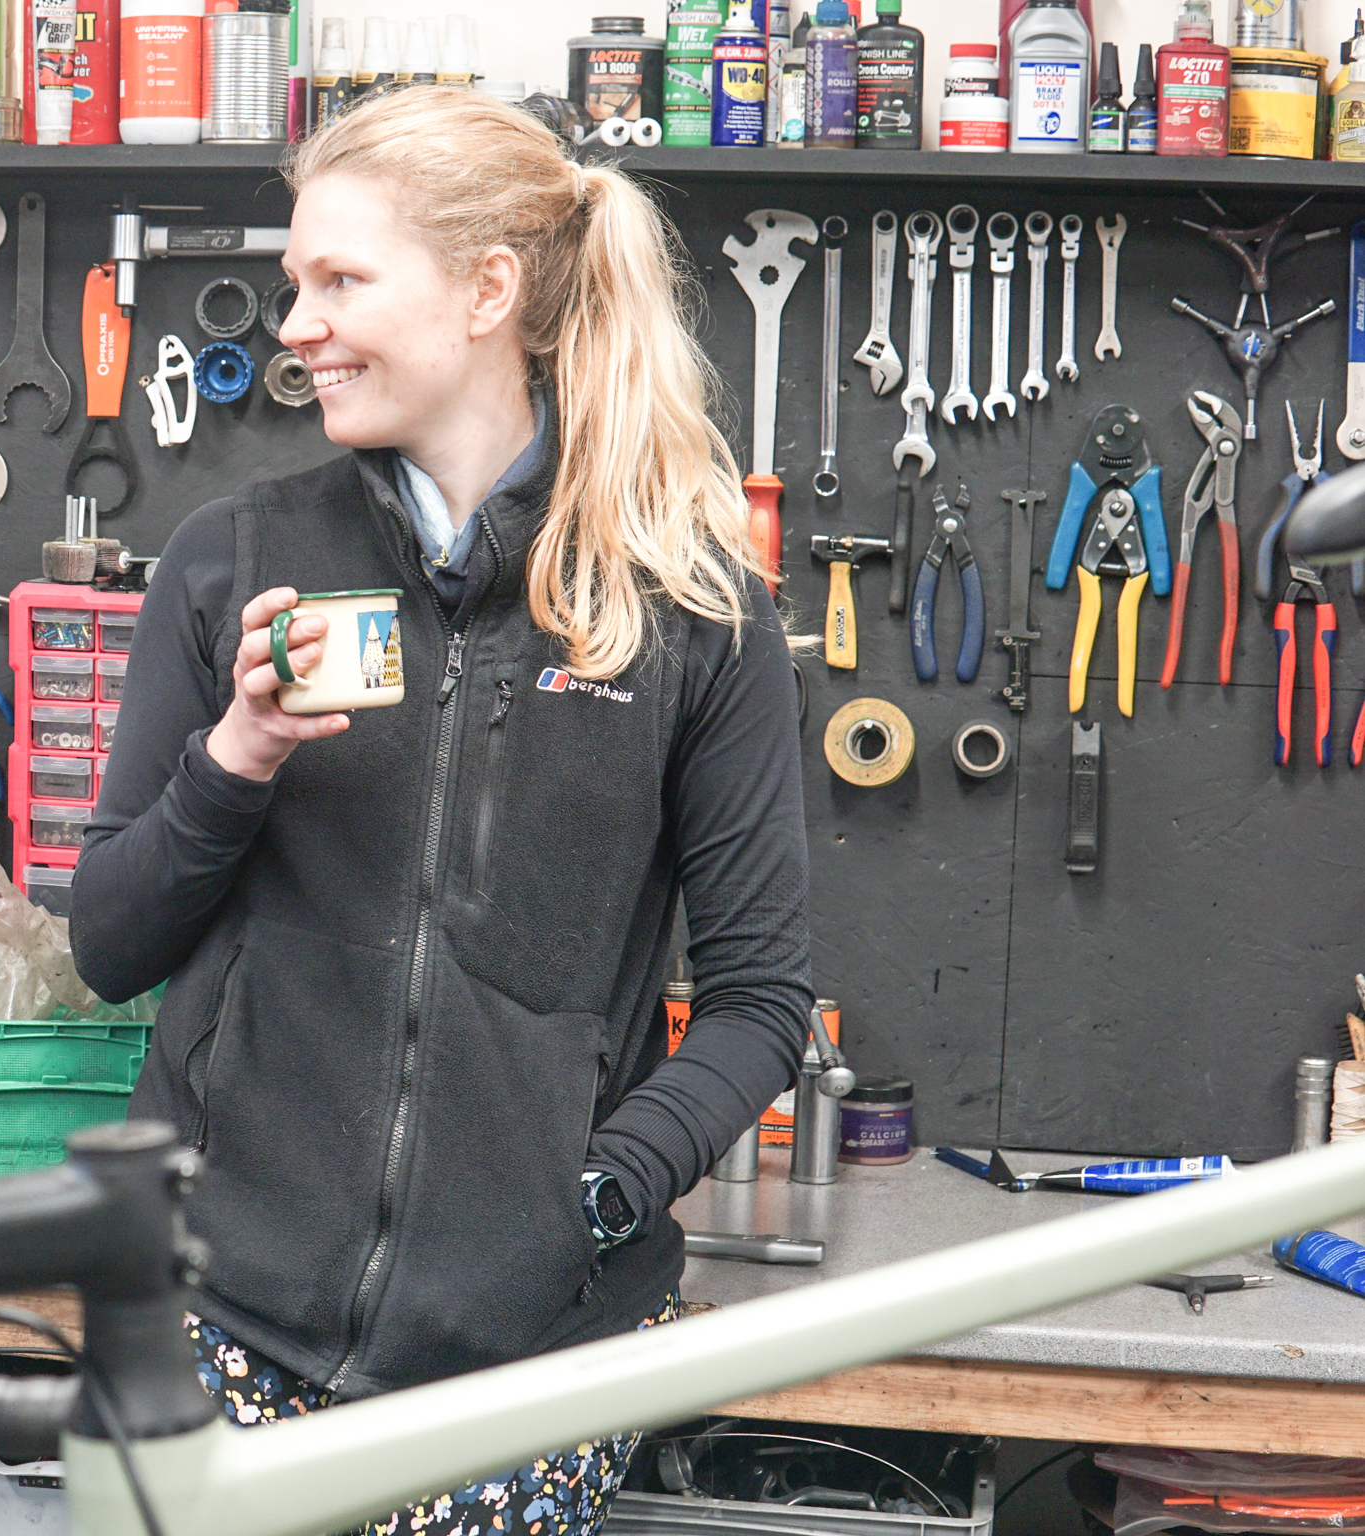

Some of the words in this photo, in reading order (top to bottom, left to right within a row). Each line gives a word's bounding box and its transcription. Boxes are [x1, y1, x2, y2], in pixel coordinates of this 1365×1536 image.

[671, 13, 695, 22] FINISH
[698, 13, 720, 22] LINE
[45, 21, 72, 33] FIBER
[135, 25, 189, 33] UNIVERSAL
[48, 32, 70, 43] GRIP
[678, 26, 708, 41] WET
[681, 41, 714, 50] LUBRICA
[588, 50, 642, 62] LOCTITE
[886, 50, 908, 58] LINE
[594, 62, 607, 74] LB
[609, 62, 636, 74] 8009
[1169, 57, 1223, 71] LOCTITE
[727, 67, 765, 84] WD-40
[858, 63, 879, 75] Cross
[880, 63, 914, 77] Country
[1036, 65, 1066, 75] LIQUI
[827, 79, 851, 87] ROLLS
[1035, 75, 1066, 85] MOLY
[1183, 70, 1210, 85] 270
[568, 678, 634, 702] berghaus
[775, 1124, 794, 1132] Labora
[860, 1130, 907, 1139] CALCIUM
